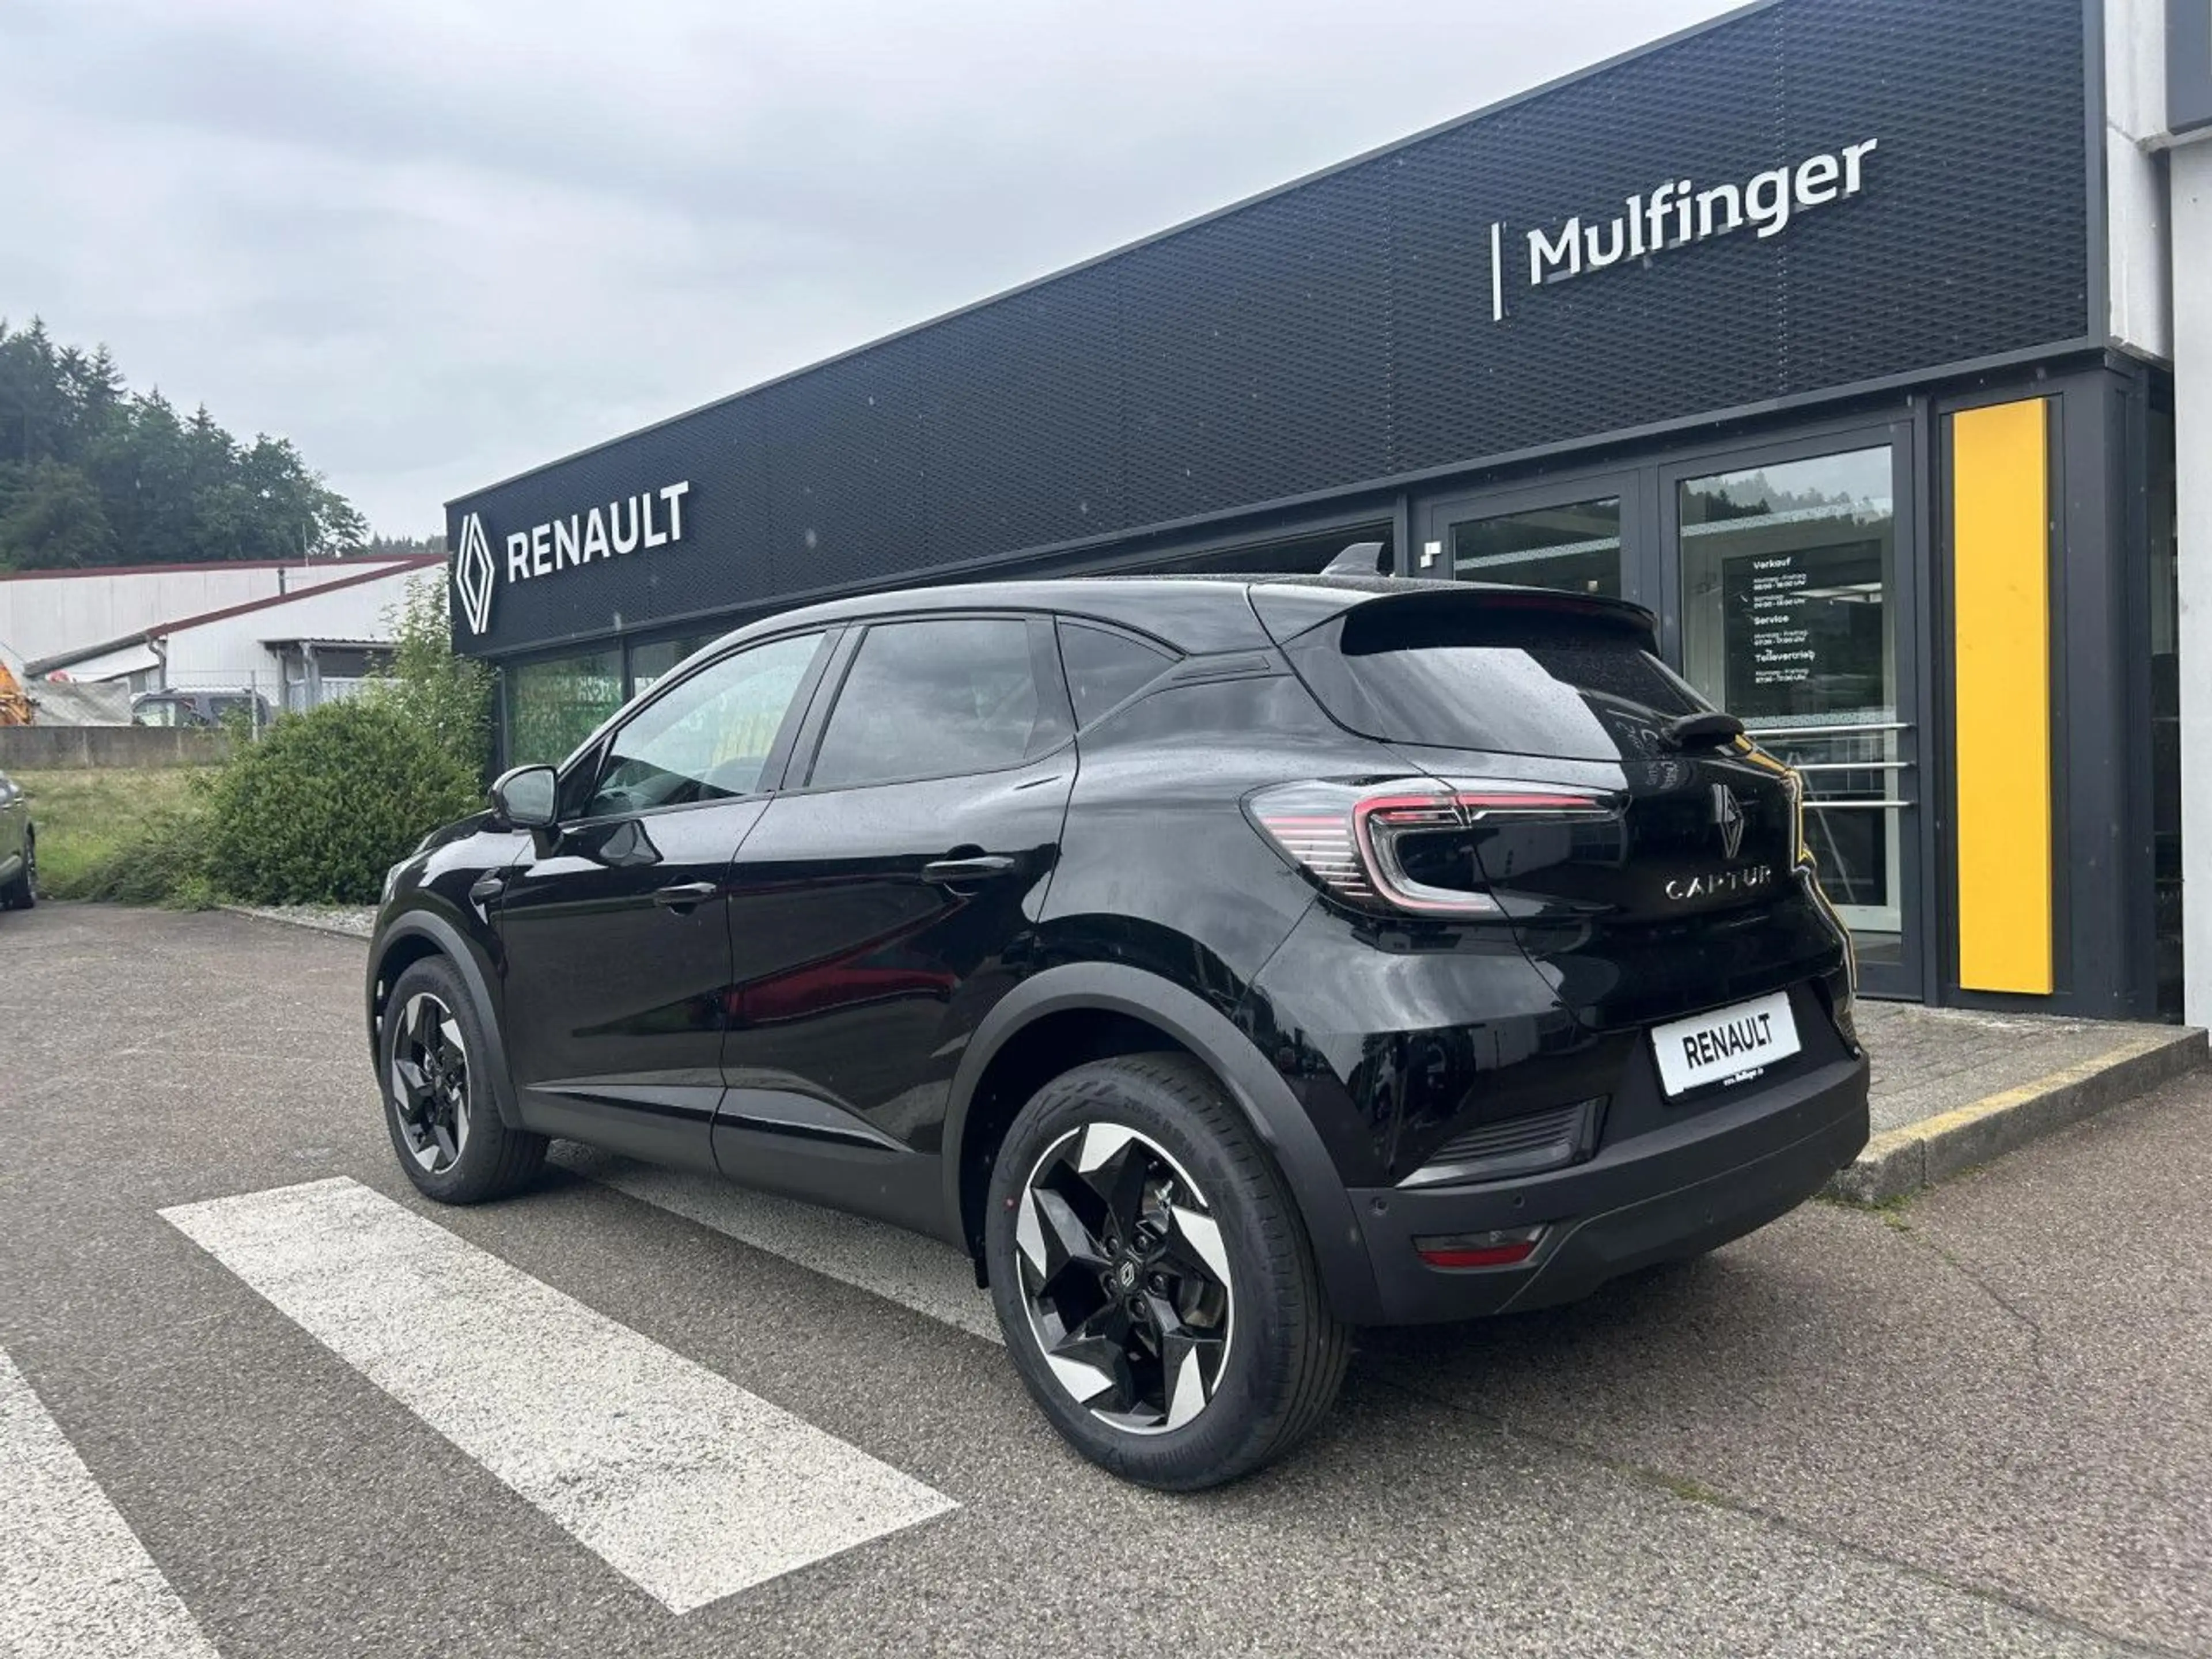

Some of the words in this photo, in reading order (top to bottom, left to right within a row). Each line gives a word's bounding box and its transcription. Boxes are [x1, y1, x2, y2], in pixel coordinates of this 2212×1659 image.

[1527, 138, 1878, 286] Mulfinger
[506, 480, 689, 584] RENAULT
[1753, 556, 1791, 569] Verkauf
[1754, 615, 1789, 625] Service
[1665, 865, 1771, 900] CAPTUR
[1682, 1012, 1772, 1070] RENAULT
